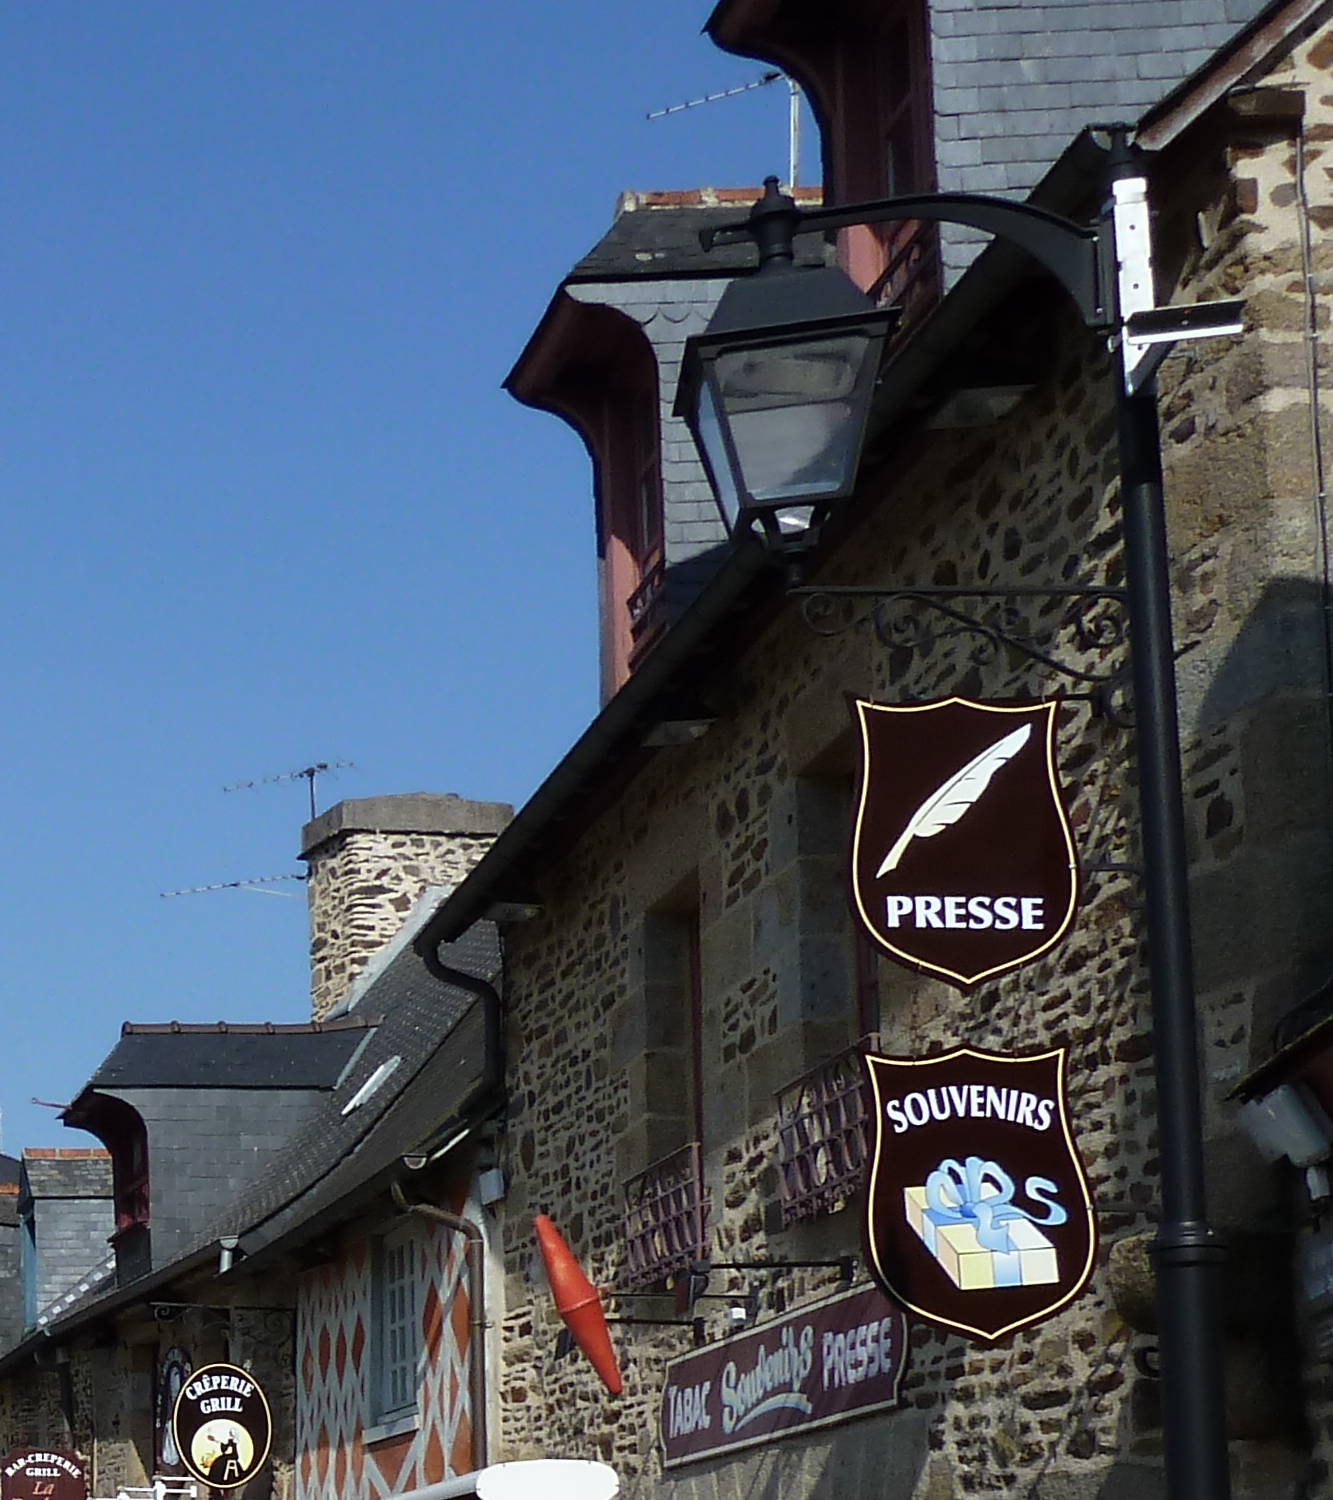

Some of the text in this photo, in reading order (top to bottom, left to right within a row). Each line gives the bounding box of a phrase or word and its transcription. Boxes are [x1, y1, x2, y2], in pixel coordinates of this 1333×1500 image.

[886, 895, 1045, 930] PRESSE
[886, 1084, 1055, 1134] SOUVENIRS
[185, 1374, 255, 1400] CRÊPERIE
[668, 1380, 712, 1439] TABAC
[822, 1317, 893, 1391] PRESSE
[200, 1397, 243, 1414] GRILL
[25, 1467, 61, 1476] GRILL
[32, 1481, 55, 1495] La
